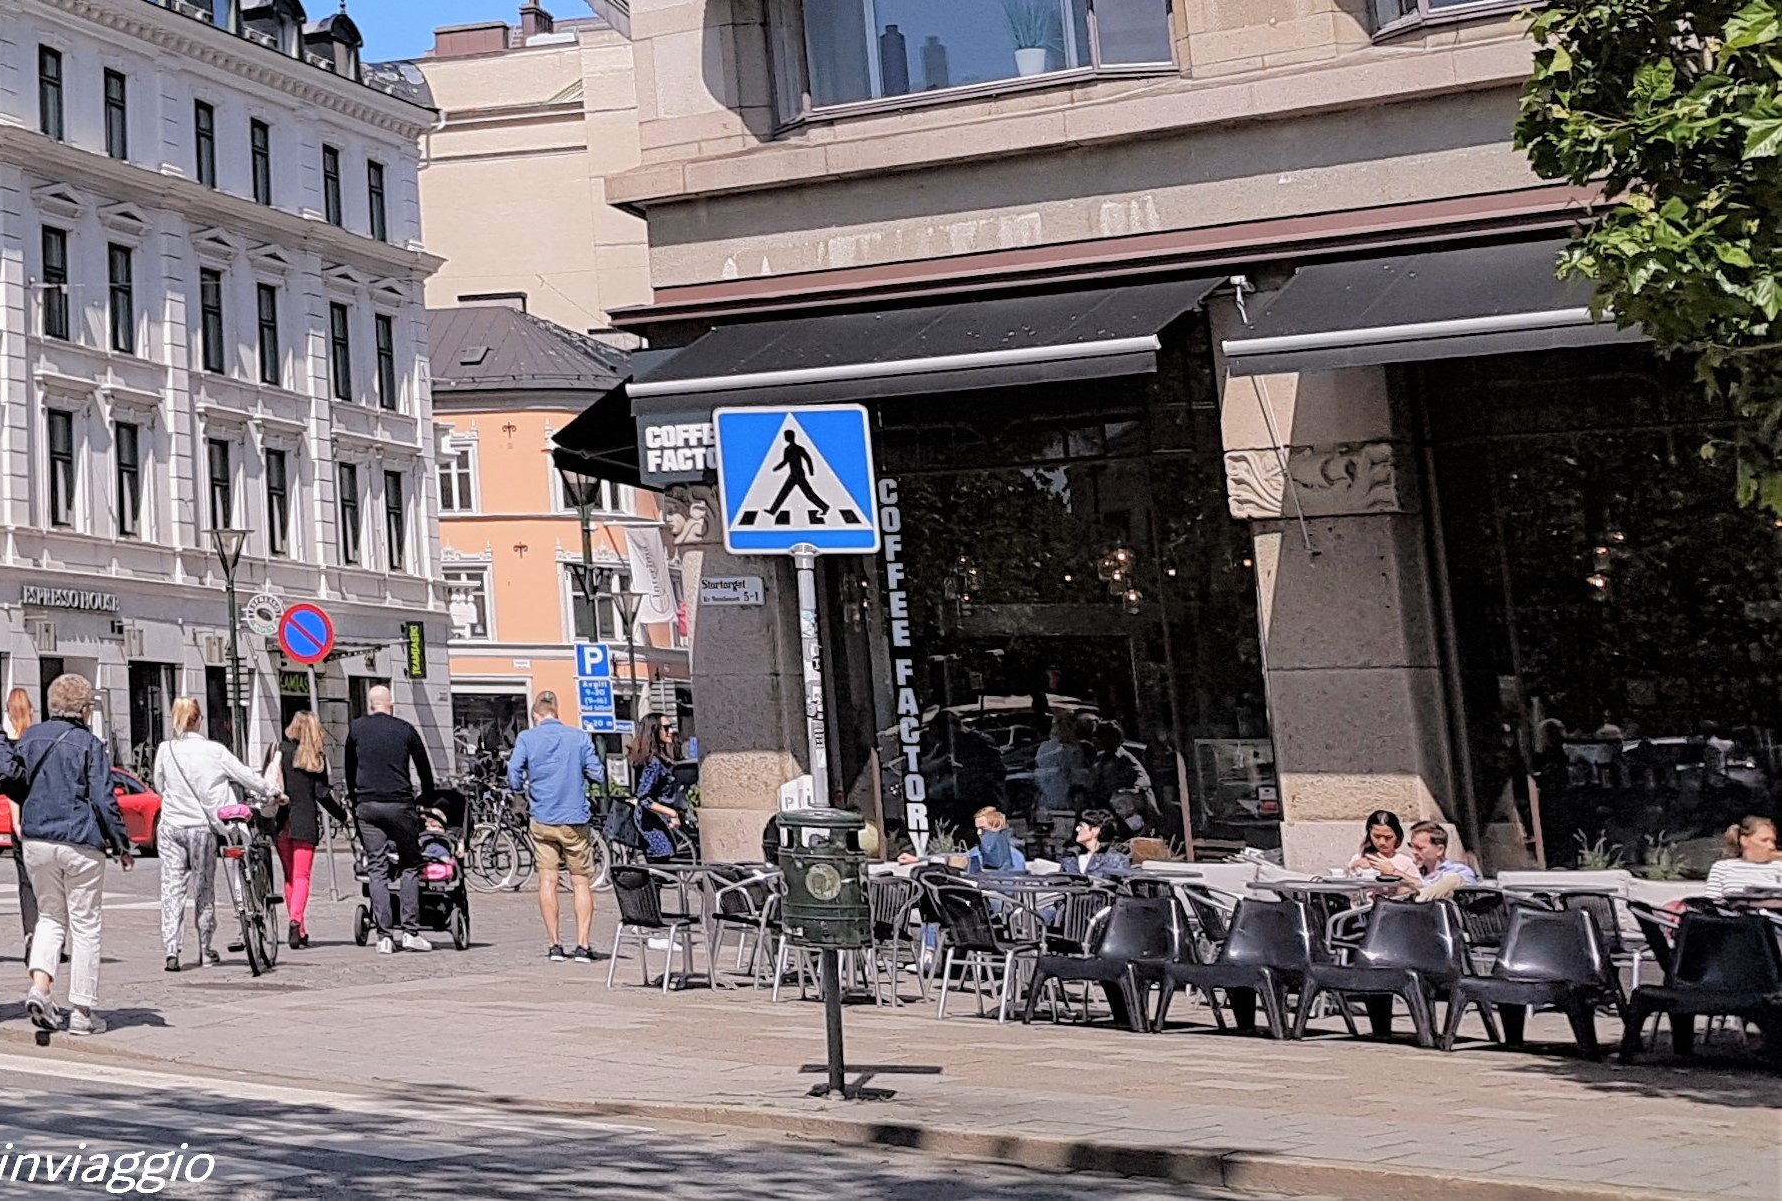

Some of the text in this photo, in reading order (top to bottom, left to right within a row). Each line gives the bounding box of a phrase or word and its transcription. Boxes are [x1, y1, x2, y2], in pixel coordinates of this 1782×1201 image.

[645, 423, 716, 448] COFFE
[647, 447, 718, 472] FACTO
[23, 585, 120, 611] ESPRESSO HOUSE
[583, 646, 604, 675] P
[877, 478, 929, 859] COFFEE FACTORY
